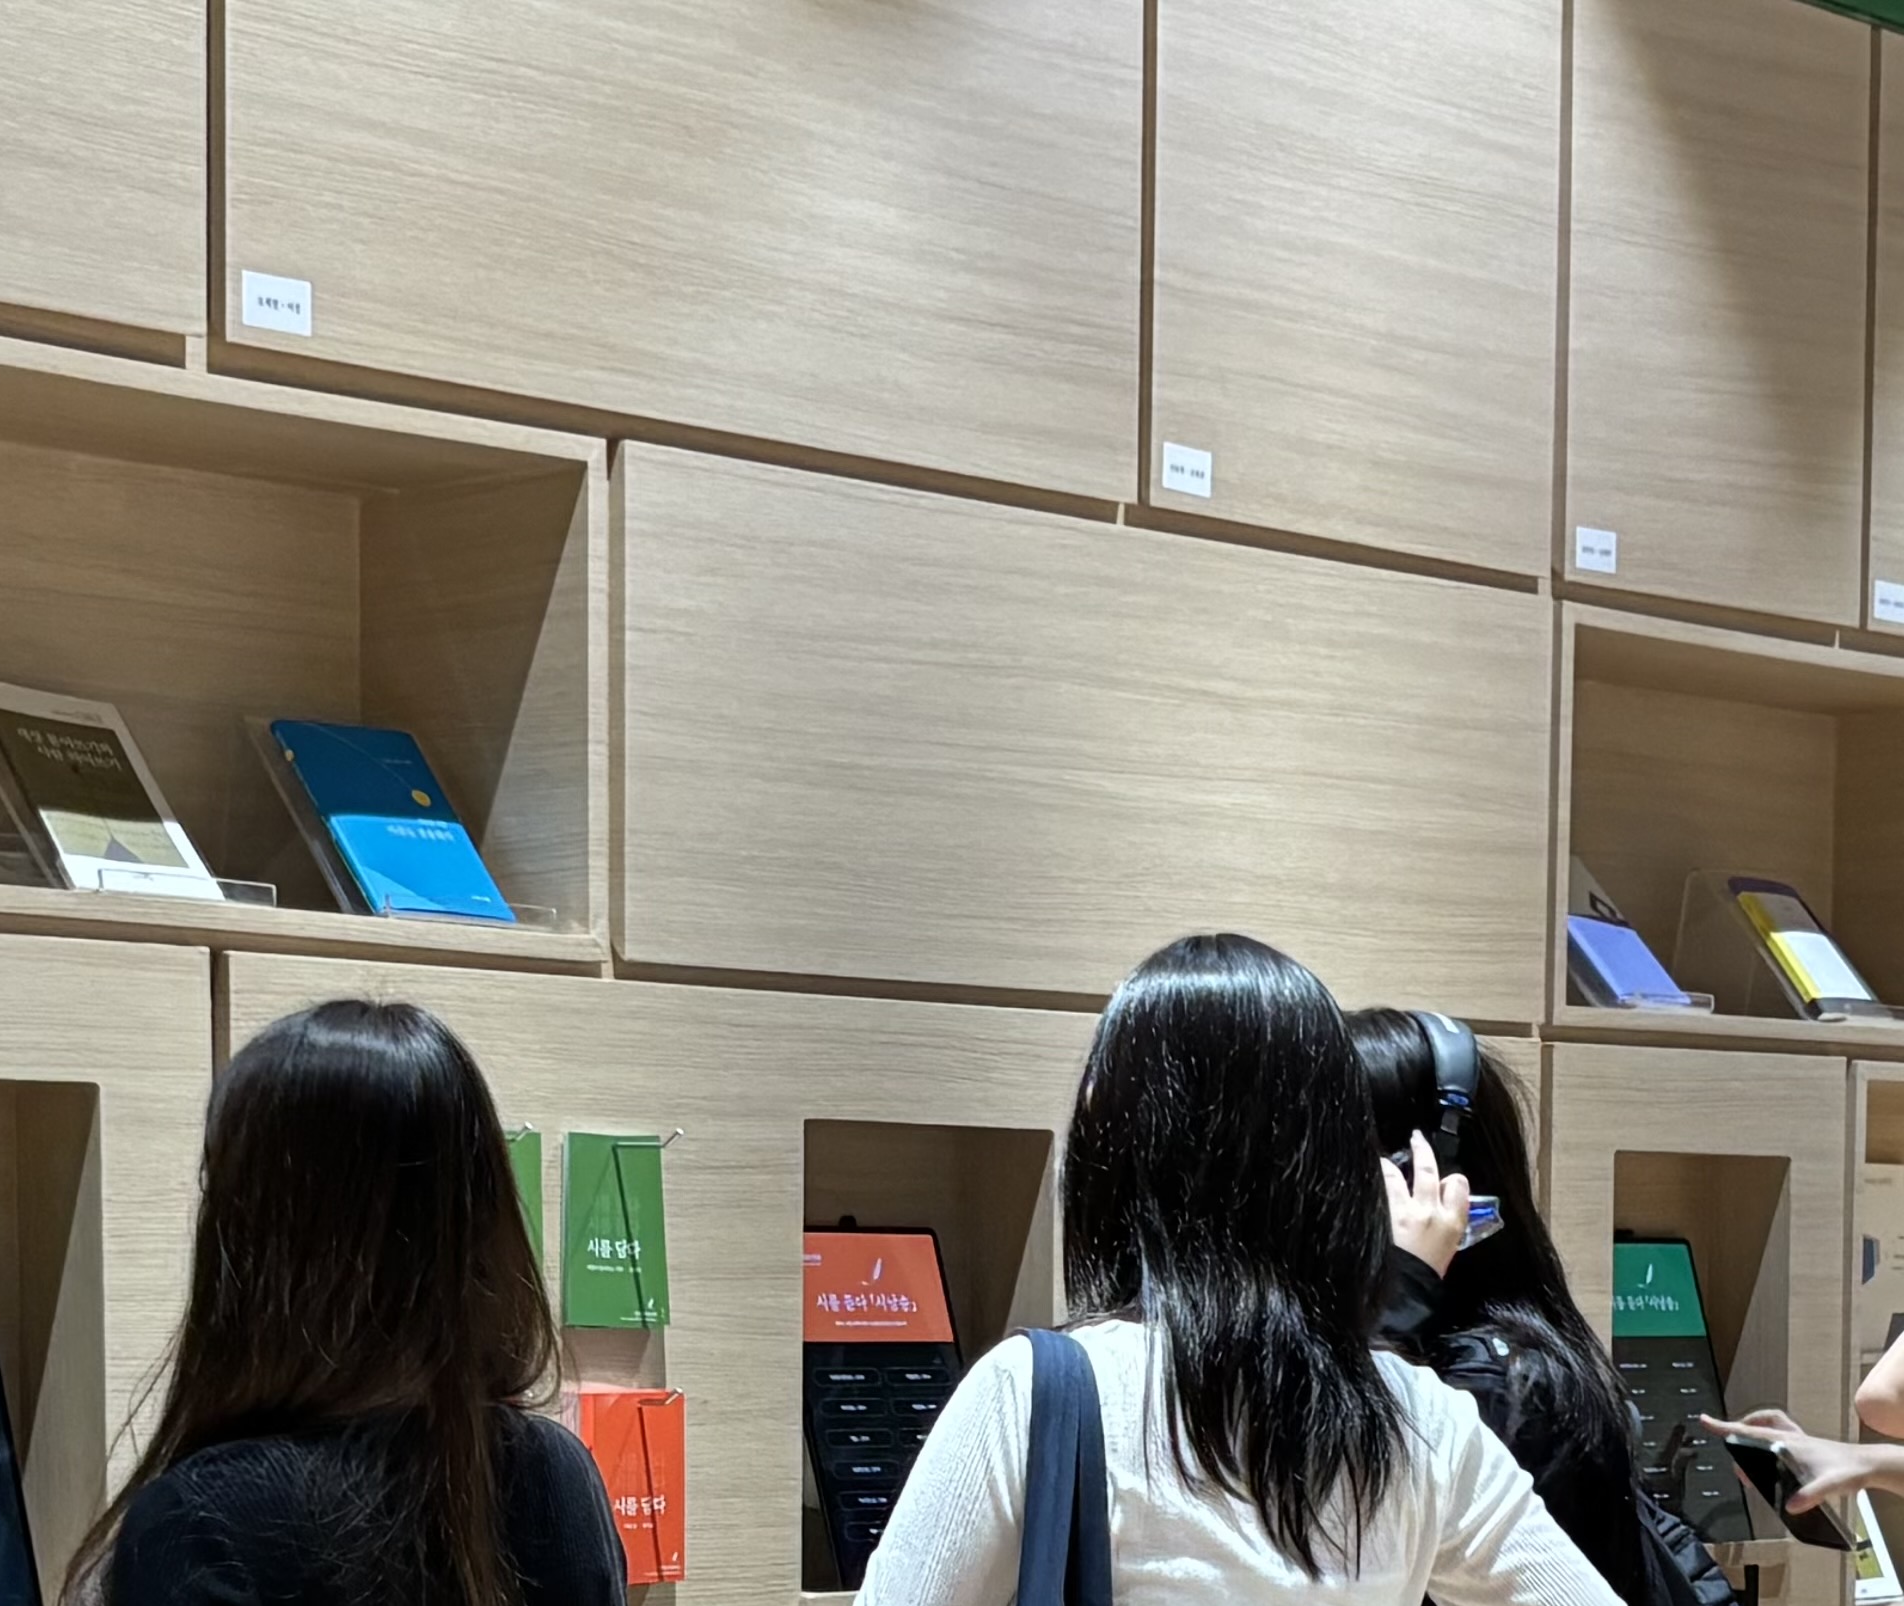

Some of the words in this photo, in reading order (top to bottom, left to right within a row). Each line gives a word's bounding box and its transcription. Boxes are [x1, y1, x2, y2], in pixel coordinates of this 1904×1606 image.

[587, 1237, 613, 1259] 시를
[817, 1292, 841, 1312] 시를
[613, 1495, 639, 1517] 시를
